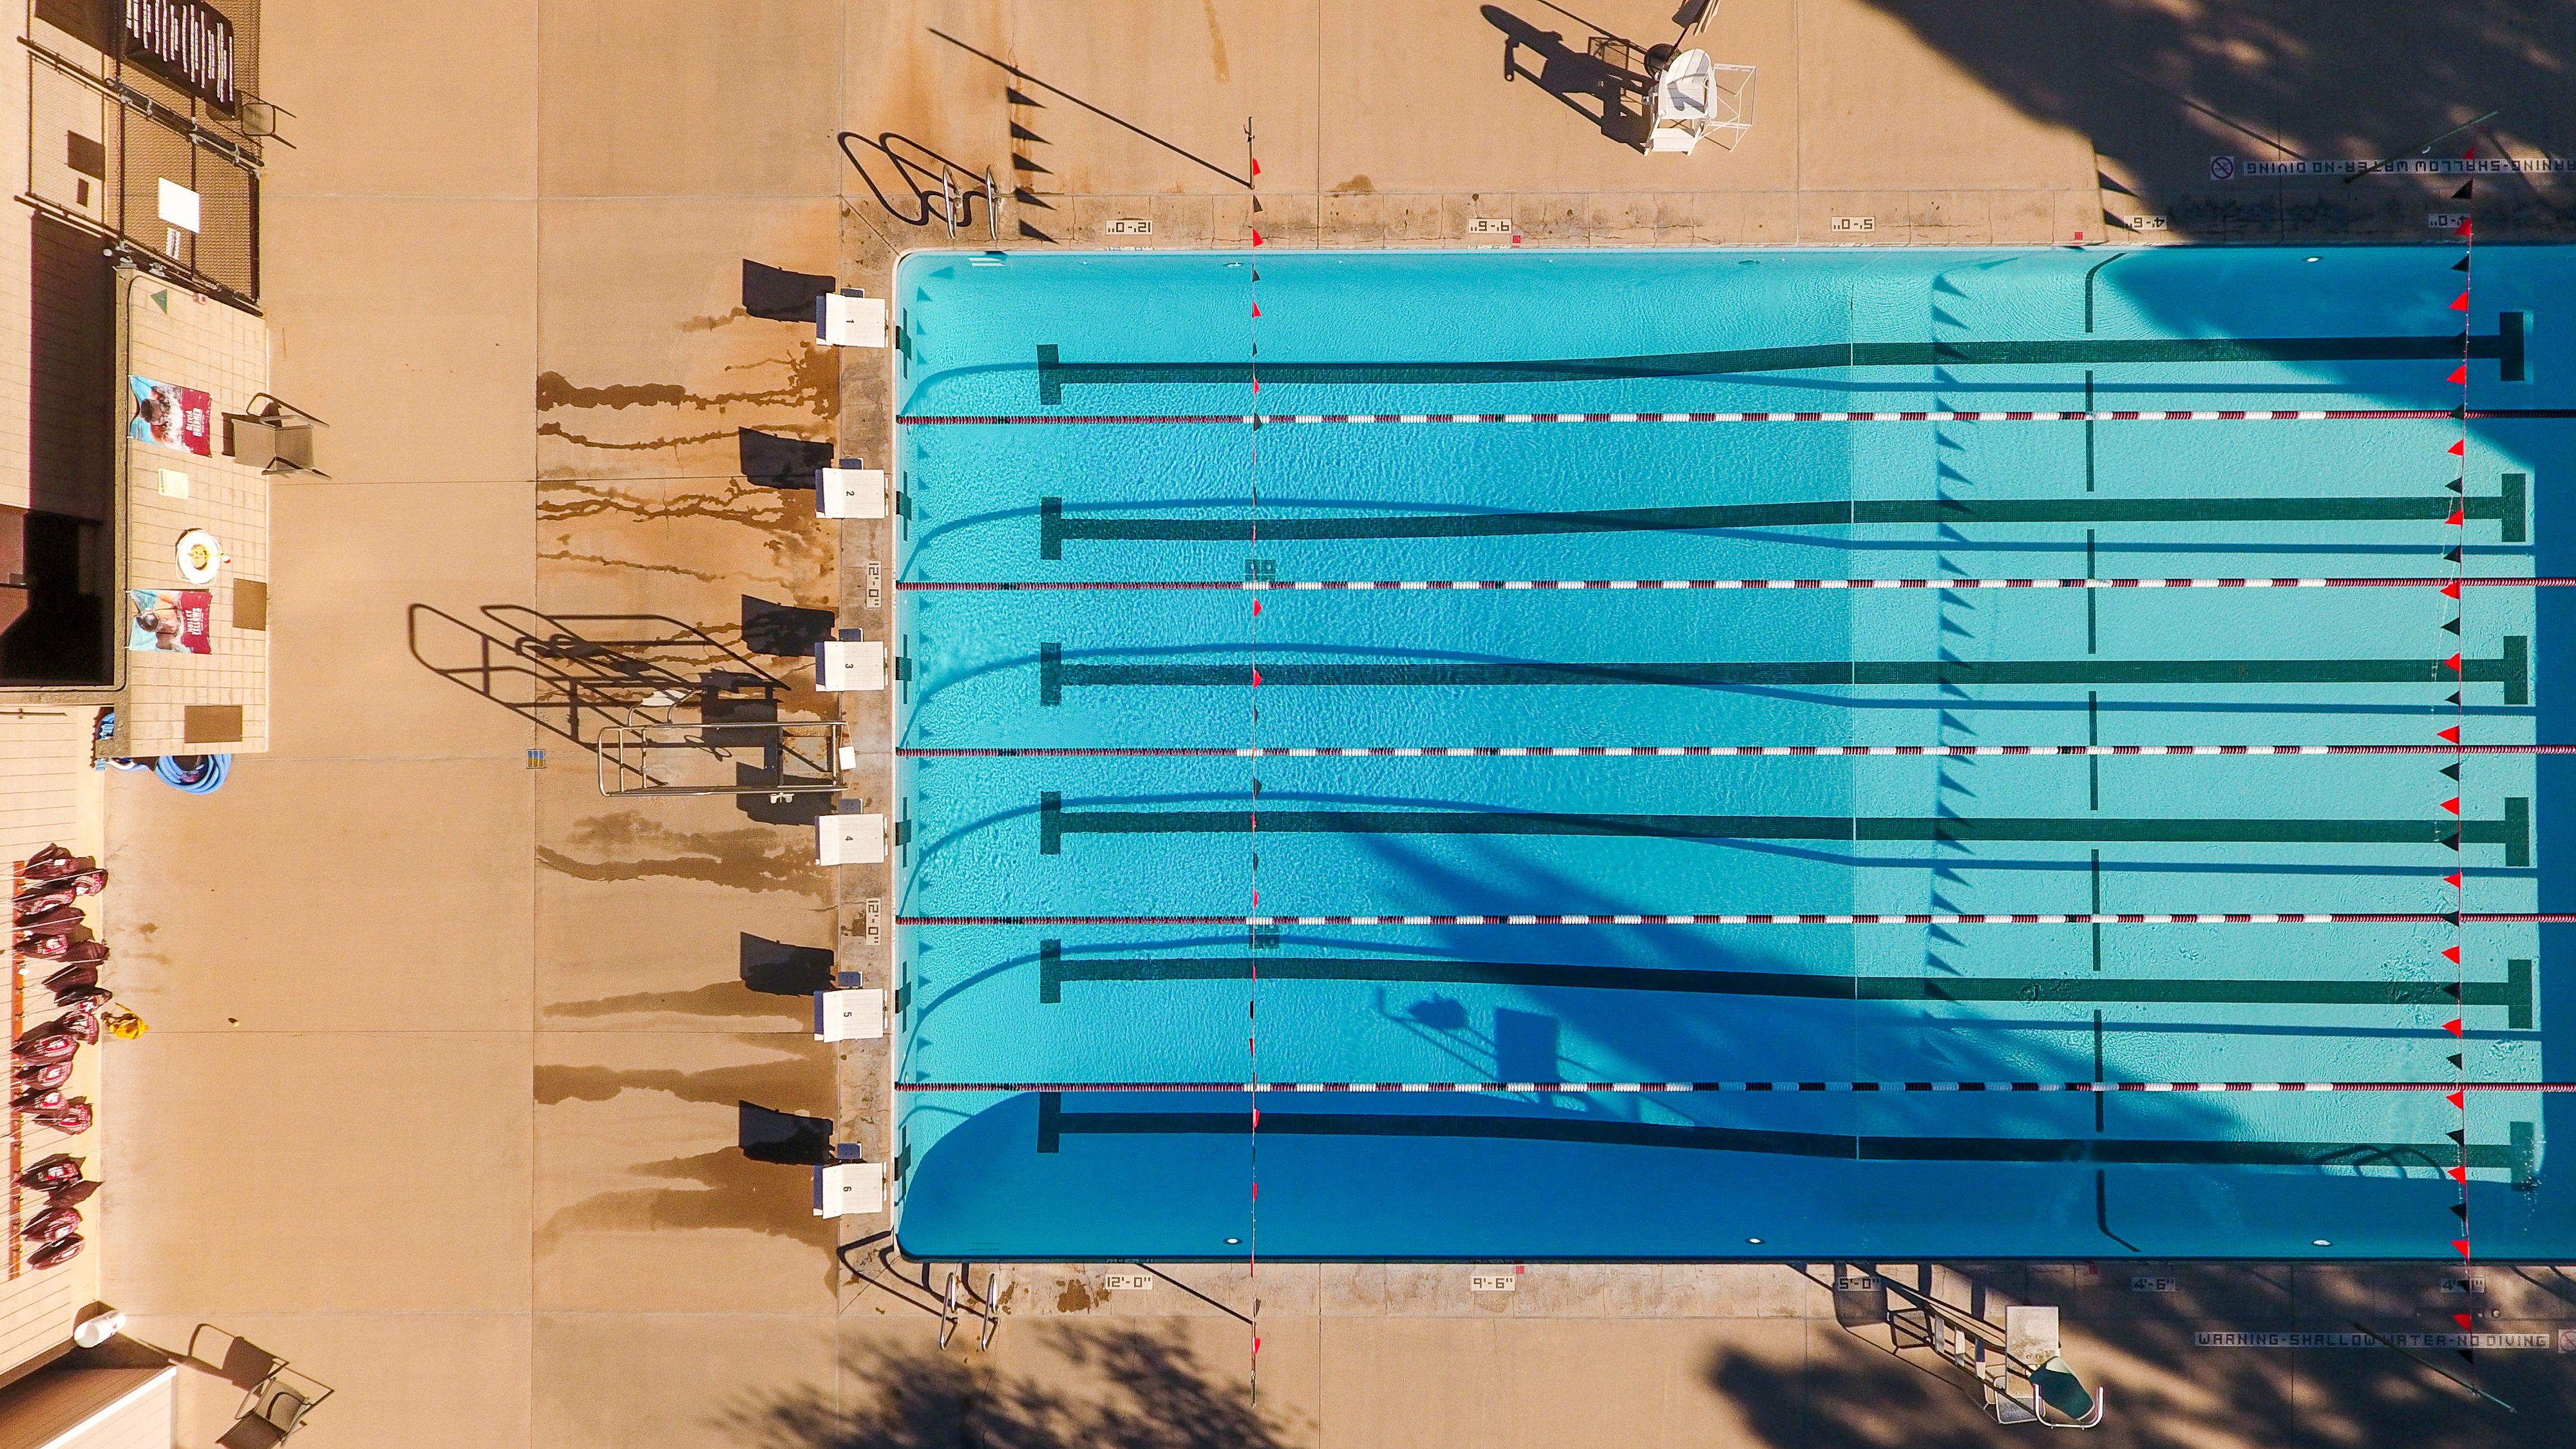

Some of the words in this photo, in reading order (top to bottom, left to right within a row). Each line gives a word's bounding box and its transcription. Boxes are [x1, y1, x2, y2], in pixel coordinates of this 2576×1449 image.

[2247, 162, 2306, 174] DIVING
[2313, 160, 2408, 173] WATER-NO
[2416, 160, 2576, 172] ARNING-SHALLOW
[1108, 222, 1150, 232] 12'-0"
[1471, 221, 1509, 231] 9'-6"
[1833, 219, 1872, 229] 5'-0"
[2126, 217, 2164, 228] 4'-6"
[869, 563, 879, 606] 12'-0"
[192, 607, 202, 635] FELLOWS
[868, 900, 878, 943] 12'-0"
[1108, 1277, 1151, 1287] 12'-0"
[1473, 1278, 1513, 1289] 9'-6"
[1840, 1278, 1879, 1289] 5'-0"
[2134, 1278, 2174, 1289] 4'-6"
[2443, 1280, 2483, 1291] 4'-"
[2199, 1333, 2376, 1346] WARNING-SHALLOW
[2486, 1334, 2546, 1347] DIVING
